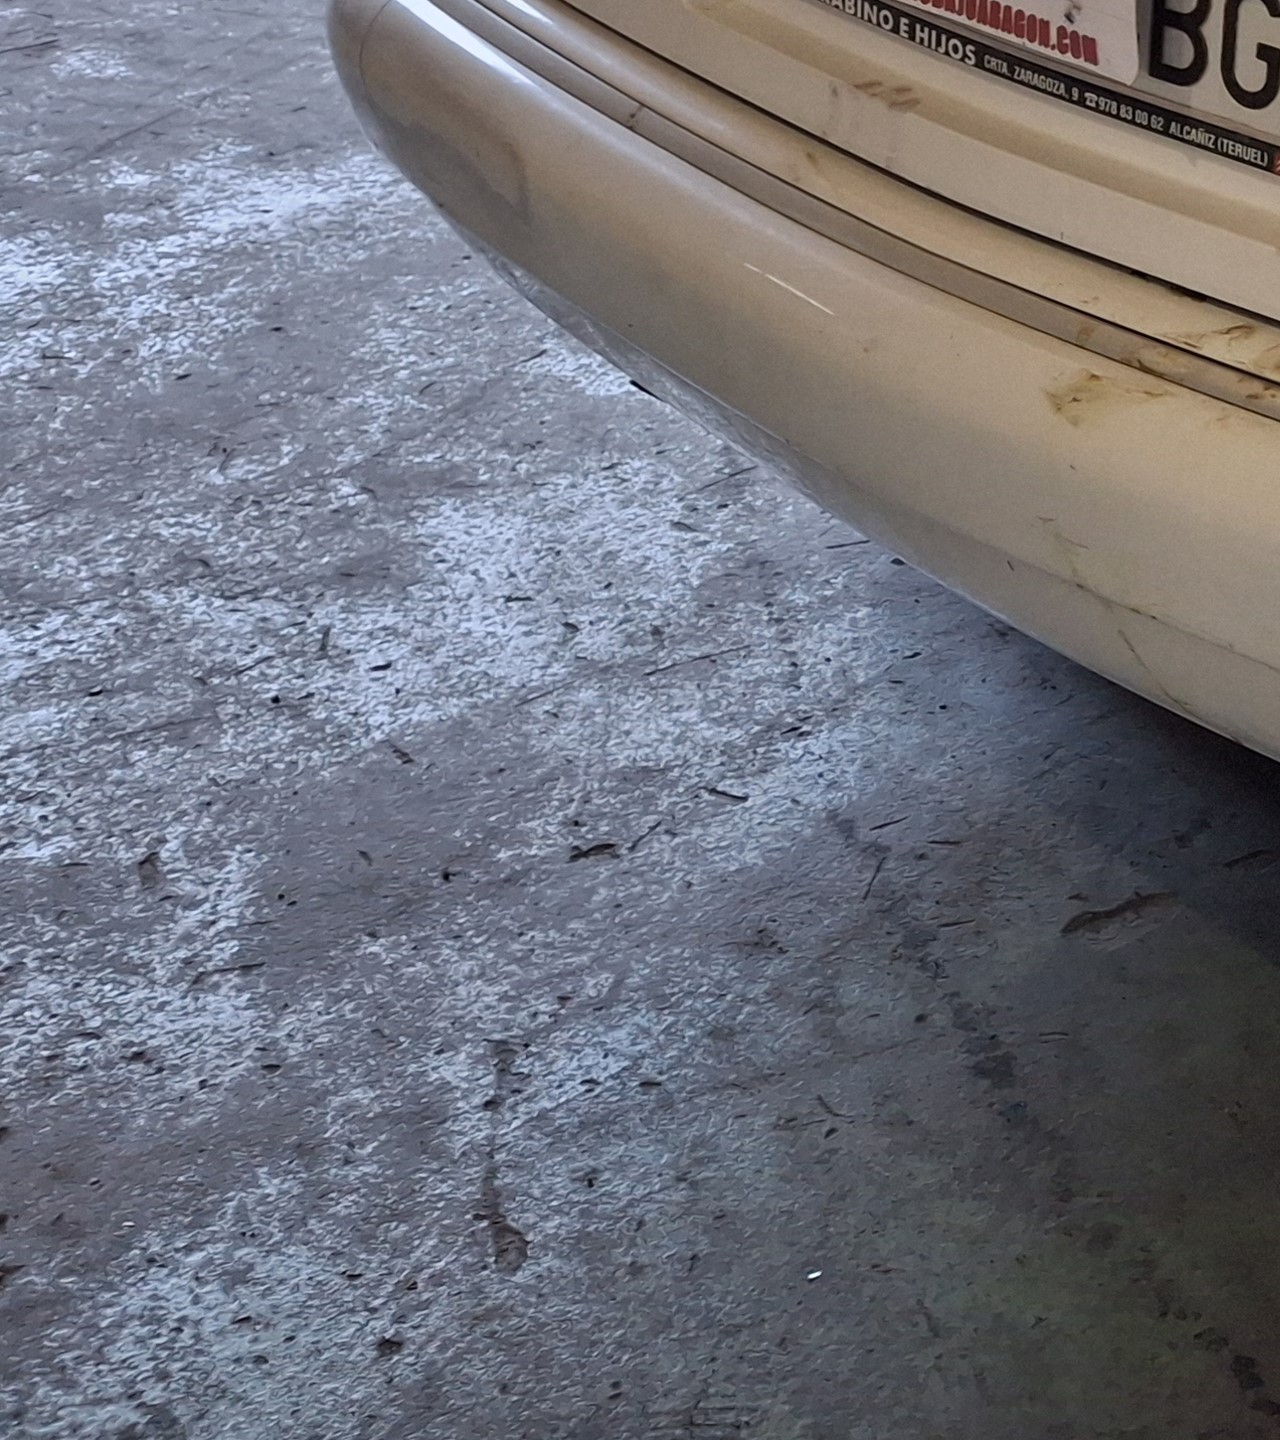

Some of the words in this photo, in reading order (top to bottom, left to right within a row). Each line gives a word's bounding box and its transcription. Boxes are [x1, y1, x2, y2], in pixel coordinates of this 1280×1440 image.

[899, 15, 910, 39] E
[914, 23, 977, 67] HIJOS
[1071, 87, 1080, 101] 9
[1097, 98, 1118, 116] 978
[1119, 104, 1134, 121] 83
[1150, 114, 1165, 132] 62
[1168, 121, 1216, 150] ALCAÑIZ
[1216, 136, 1269, 168] (TERUEL)
